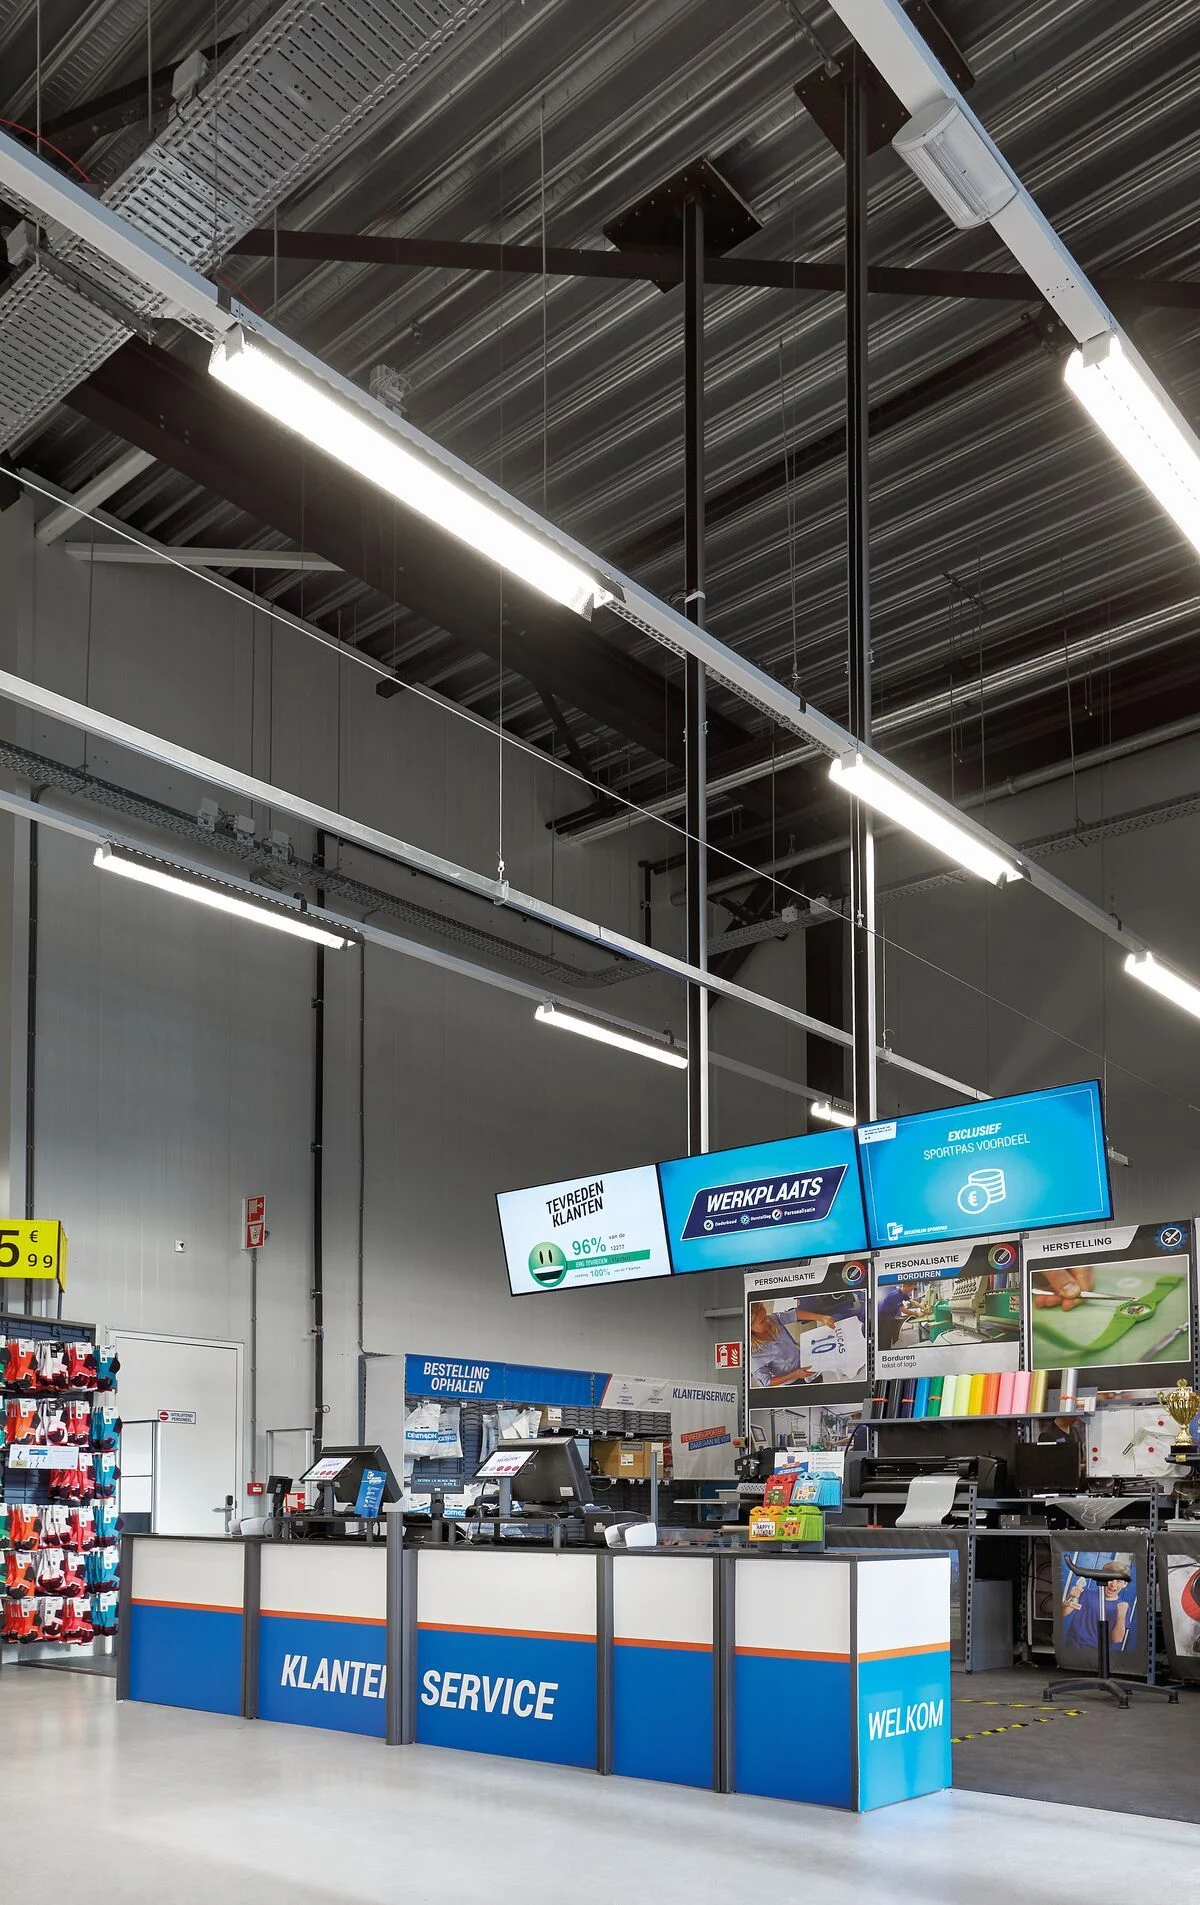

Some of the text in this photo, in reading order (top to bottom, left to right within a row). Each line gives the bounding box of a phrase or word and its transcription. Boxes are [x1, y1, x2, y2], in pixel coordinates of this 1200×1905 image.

[948, 1123, 1002, 1142] EXCLUSIEF
[924, 1133, 1031, 1160] SPORTPAS VOORDEEL
[546, 1180, 605, 1215] TEVREDEN
[707, 1176, 824, 1213] WERKPLAATS
[552, 1196, 604, 1228] KLANTEN
[29, 1230, 39, 1243] €
[1042, 1237, 1112, 1252] HERSTELLING
[572, 1236, 606, 1256] 96%
[884, 1255, 960, 1269] PERSONALISATIE
[590, 1268, 611, 1277] 100%
[754, 1272, 816, 1286] PERSONALISATIE
[897, 1270, 941, 1281] BORDUREN
[811, 1335, 837, 1354] 10
[835, 1327, 846, 1354] LUCAS
[881, 1354, 915, 1362] Borduren
[903, 1360, 917, 1368] logo
[423, 1362, 490, 1380] BESTELLING
[431, 1377, 484, 1394] OPHALEN
[672, 1387, 736, 1403] KLANTENSERVICE
[421, 1669, 559, 1721] SERVICE
[868, 1698, 944, 1741] WELKOM
